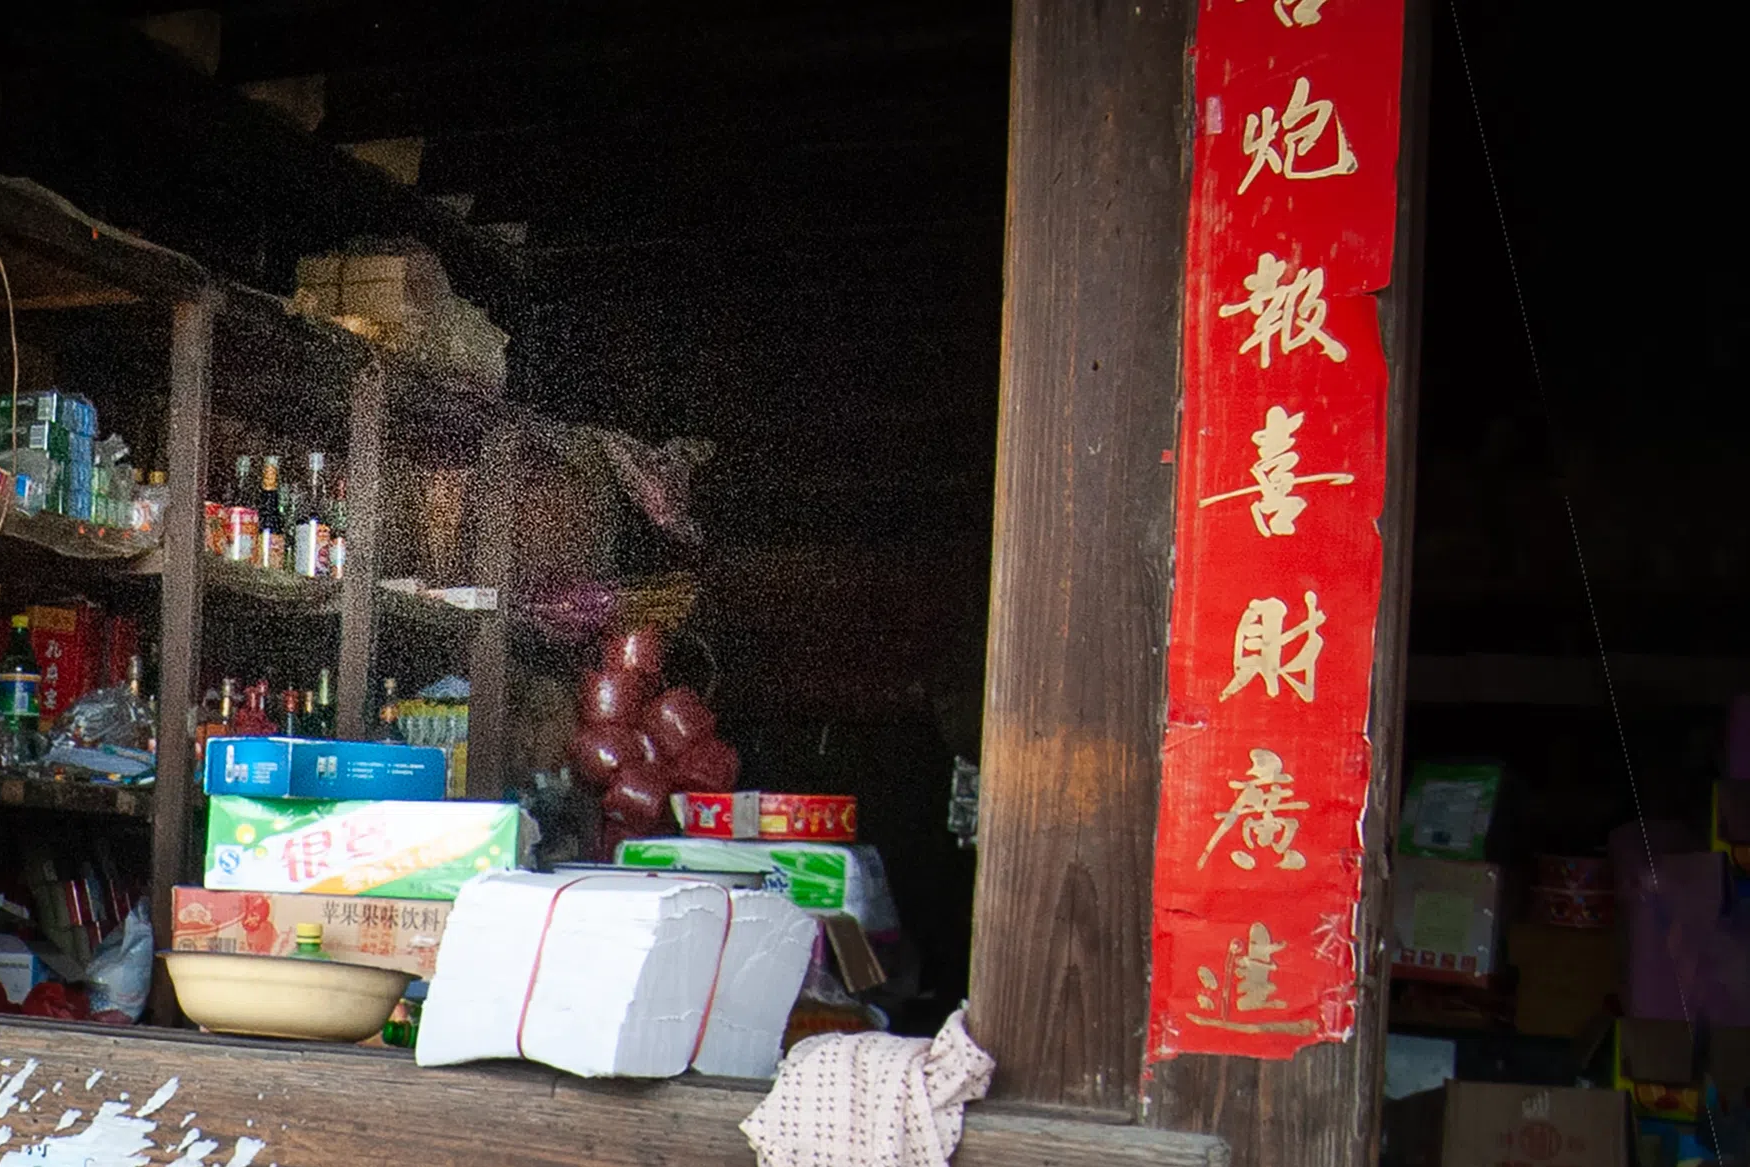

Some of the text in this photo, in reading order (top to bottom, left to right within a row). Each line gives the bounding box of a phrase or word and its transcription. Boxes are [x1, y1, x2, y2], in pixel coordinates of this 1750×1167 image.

[1186, 0, 1358, 1034] 炮報喜財廣進
